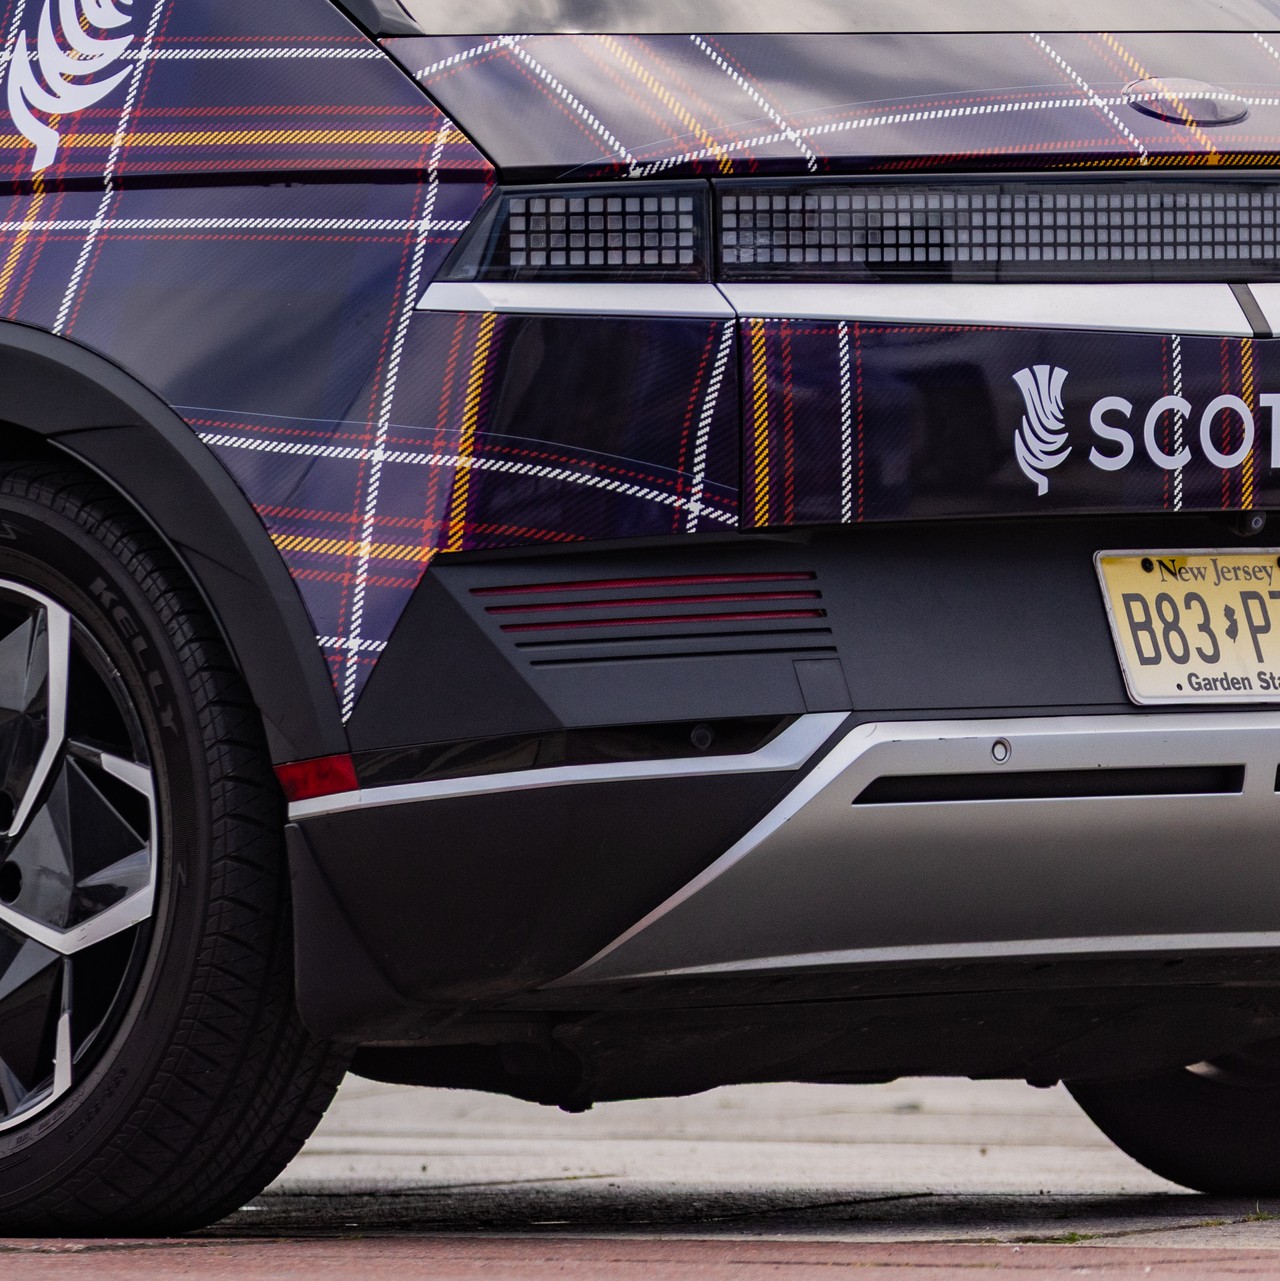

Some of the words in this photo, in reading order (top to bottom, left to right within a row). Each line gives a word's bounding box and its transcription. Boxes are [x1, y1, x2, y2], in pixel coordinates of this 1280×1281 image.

[1156, 559, 1207, 582] New
[1210, 558, 1274, 587] Jersey
[88, 577, 179, 736] KELLY
[1187, 672, 1253, 692] Garden
[1257, 671, 1280, 690] St
